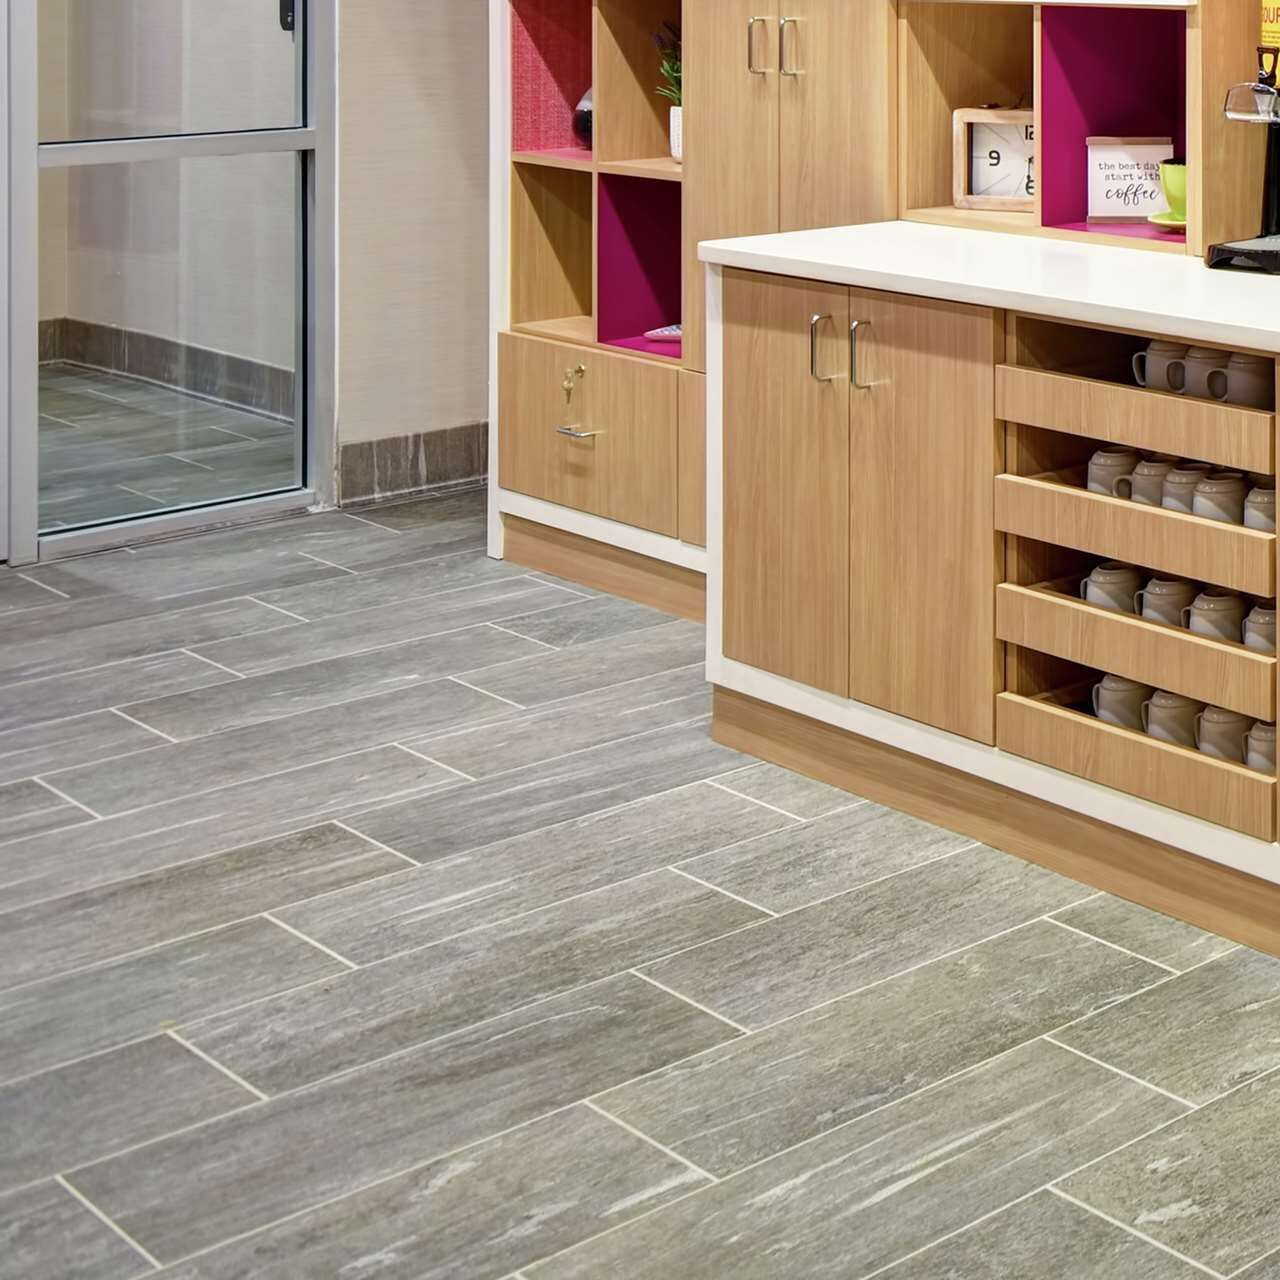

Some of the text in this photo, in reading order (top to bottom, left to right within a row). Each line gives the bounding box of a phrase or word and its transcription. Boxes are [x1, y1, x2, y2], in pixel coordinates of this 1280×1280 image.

[988, 150, 1001, 167] 9
[1098, 162, 1116, 171] the
[1118, 162, 1142, 171] best
[1104, 171, 1161, 181] start with
[1105, 183, 1159, 206] coffee
